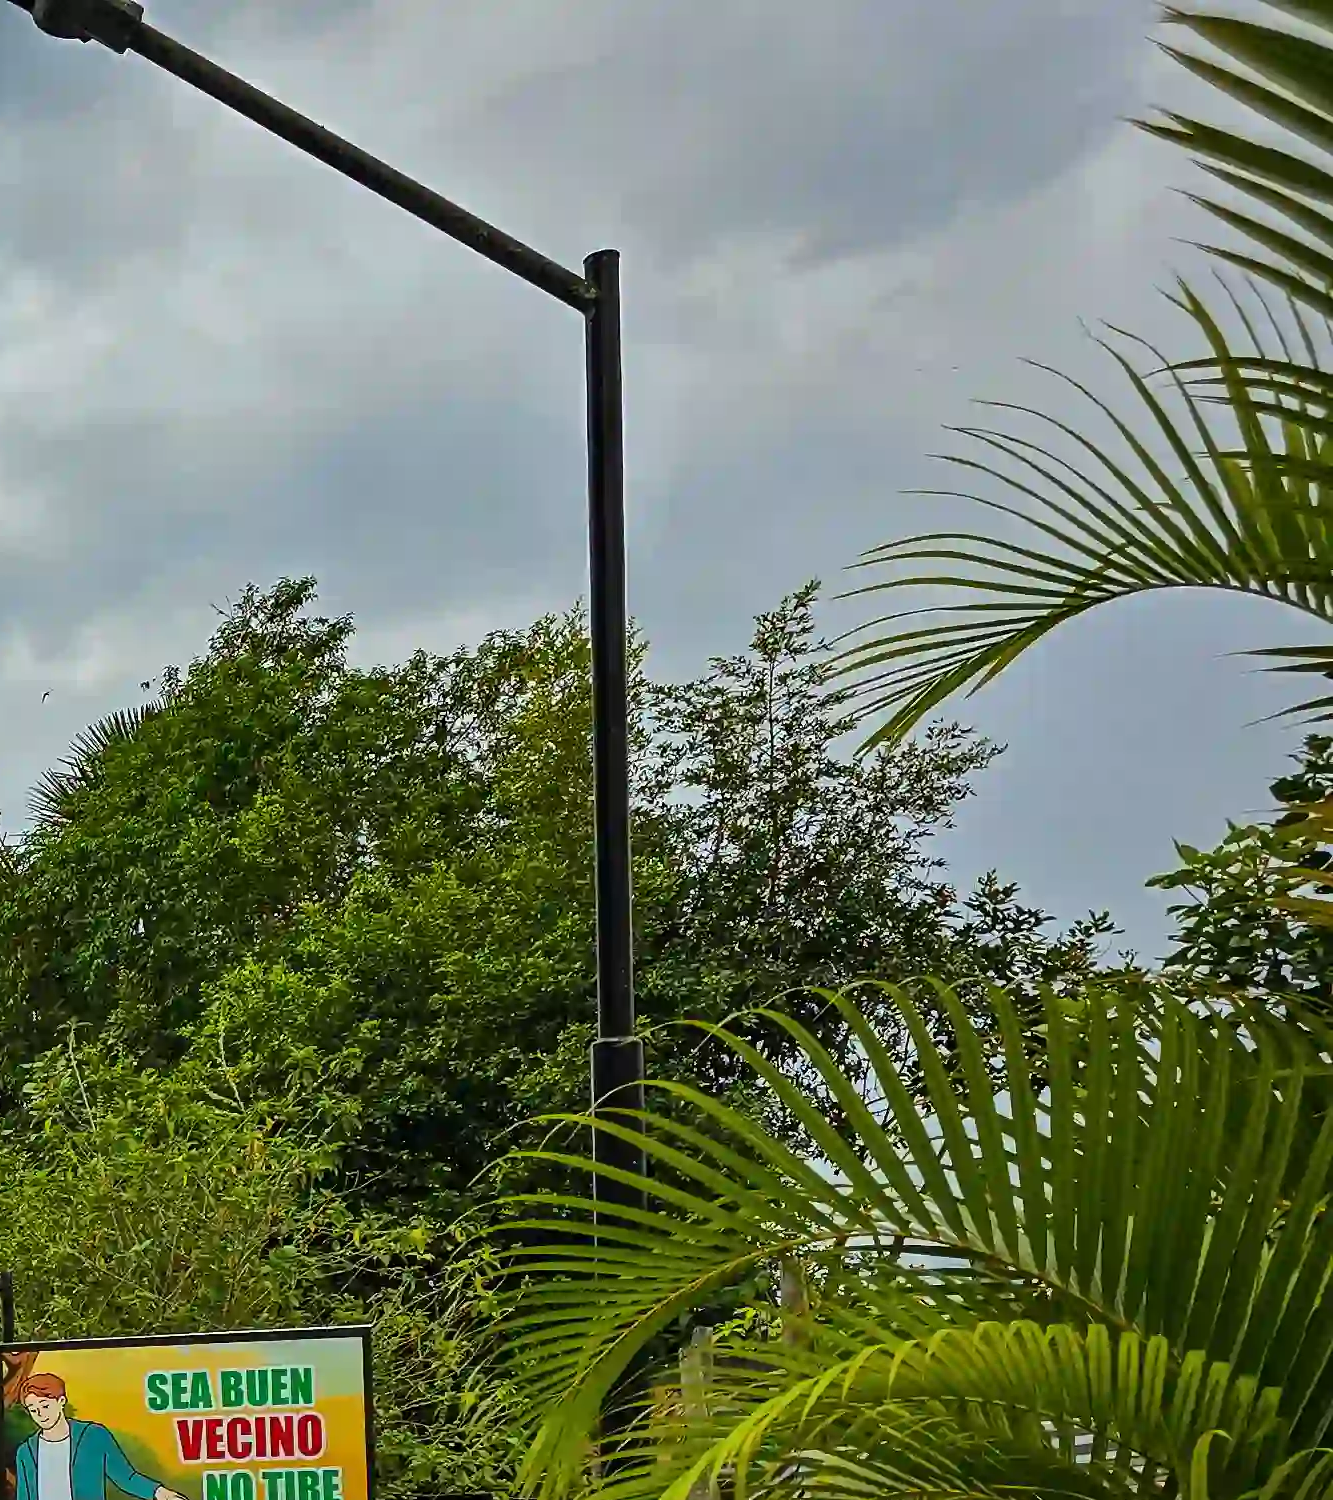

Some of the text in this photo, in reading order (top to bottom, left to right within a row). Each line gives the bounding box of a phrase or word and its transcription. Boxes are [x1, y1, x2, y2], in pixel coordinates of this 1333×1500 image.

[147, 1367, 314, 1411] SEA BUEN
[177, 1415, 323, 1461] VECINO
